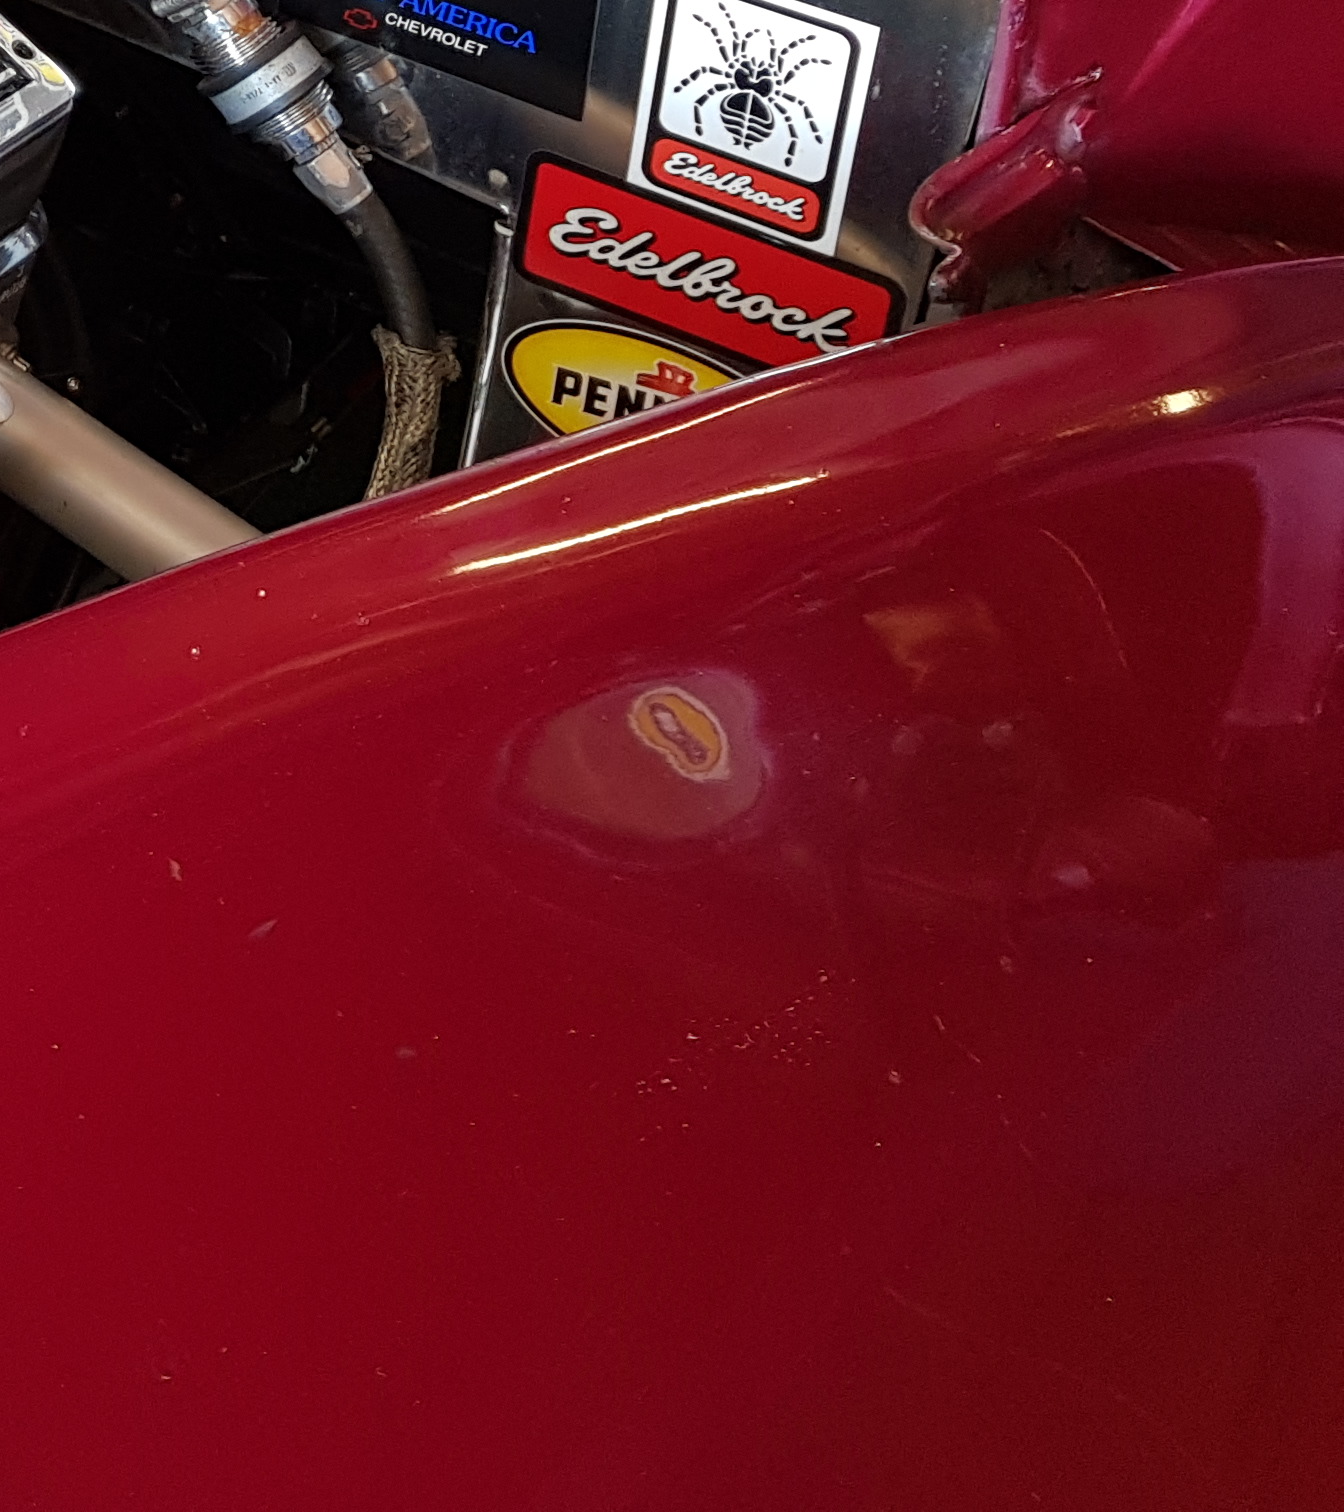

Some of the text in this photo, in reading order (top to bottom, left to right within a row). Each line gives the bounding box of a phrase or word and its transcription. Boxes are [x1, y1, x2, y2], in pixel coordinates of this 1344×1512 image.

[384, 11, 489, 58] CHEVROLET
[662, 151, 806, 222] Edelbrock
[547, 206, 855, 354] Edelbrock
